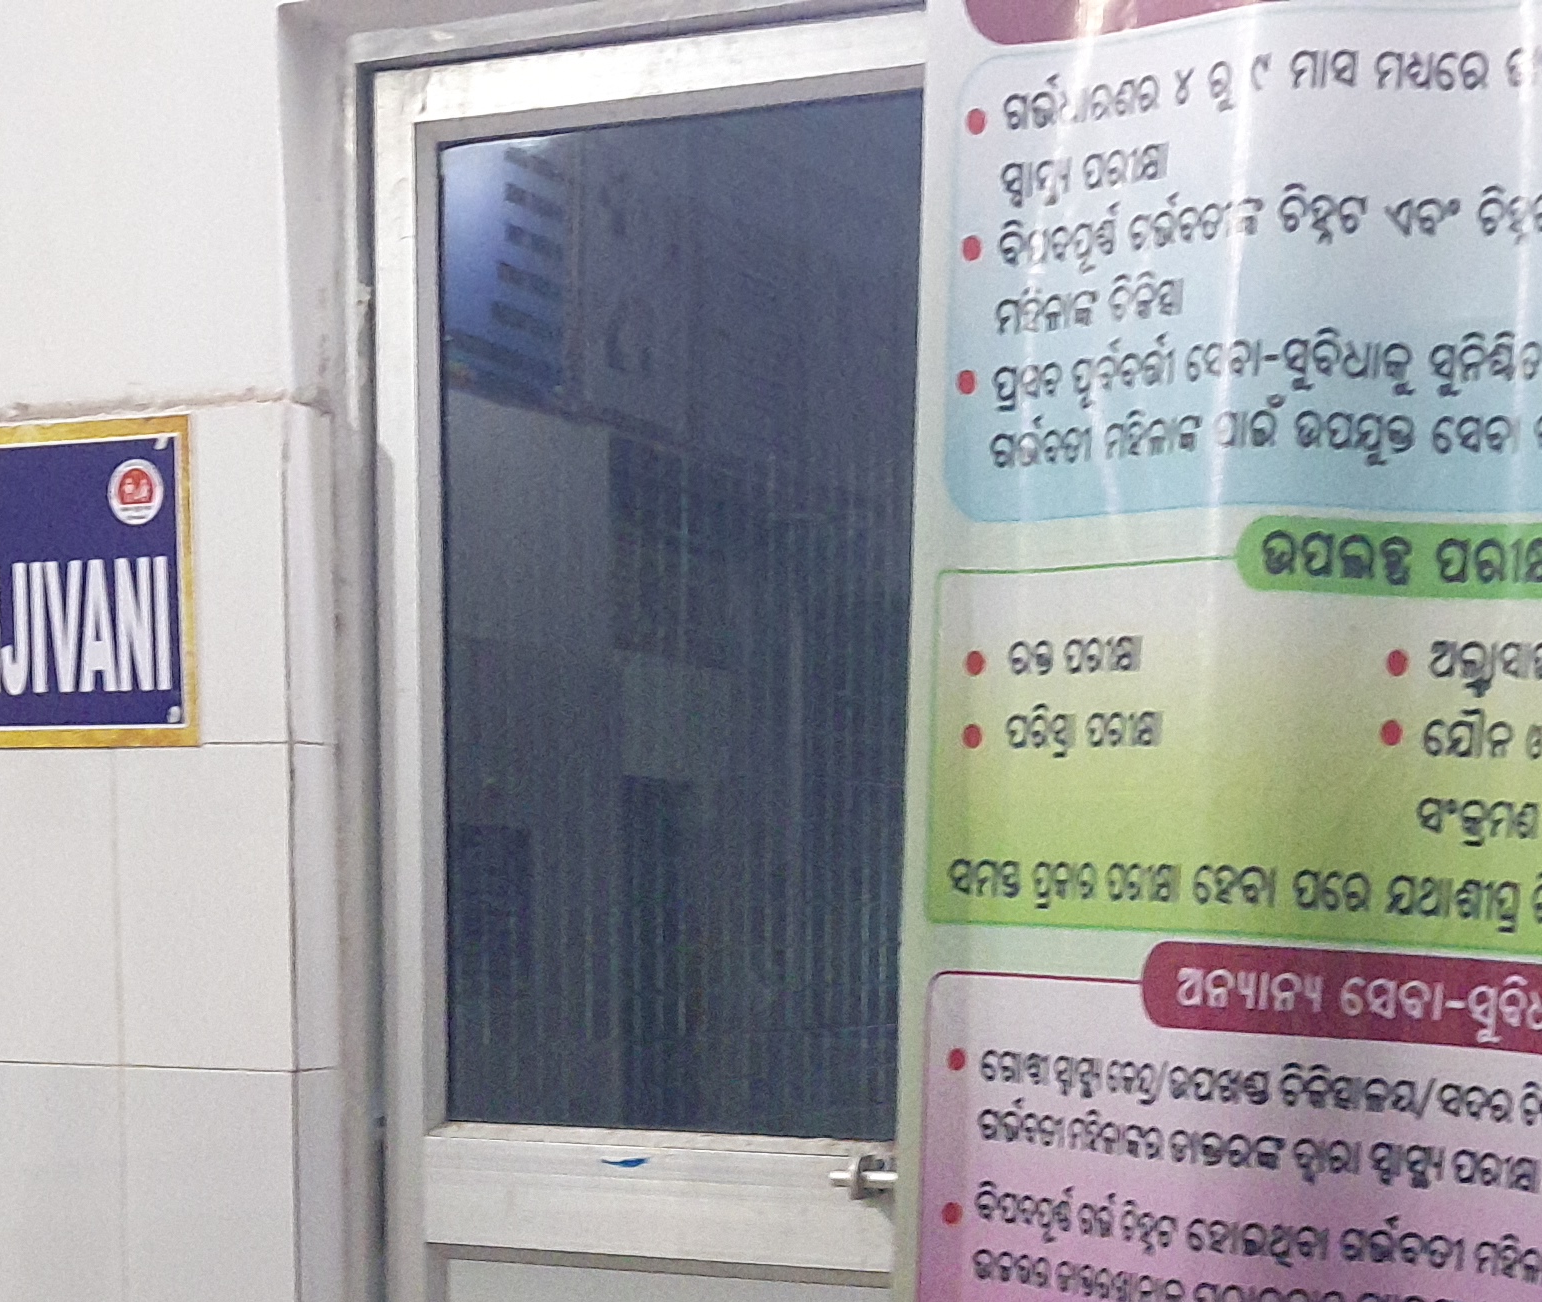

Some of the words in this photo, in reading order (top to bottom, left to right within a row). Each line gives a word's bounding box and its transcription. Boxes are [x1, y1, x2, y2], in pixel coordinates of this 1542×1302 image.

[1174, 66, 1193, 105] ୪
[1208, 59, 1234, 111] ରୁ
[1291, 48, 1359, 90] ମାସ
[1375, 49, 1488, 91] ମଧ୍ୟରେ
[1083, 142, 1170, 189] ପରୀକ୍ଷା
[1278, 183, 1368, 246] ଚିହ୍ନଟ
[1384, 195, 1461, 238] ଏବଂ
[989, 413, 1090, 468] ଗର୍ଭବତୀ
[1431, 412, 1519, 455] ସେବା
[1292, 868, 1373, 914] ପରେ
